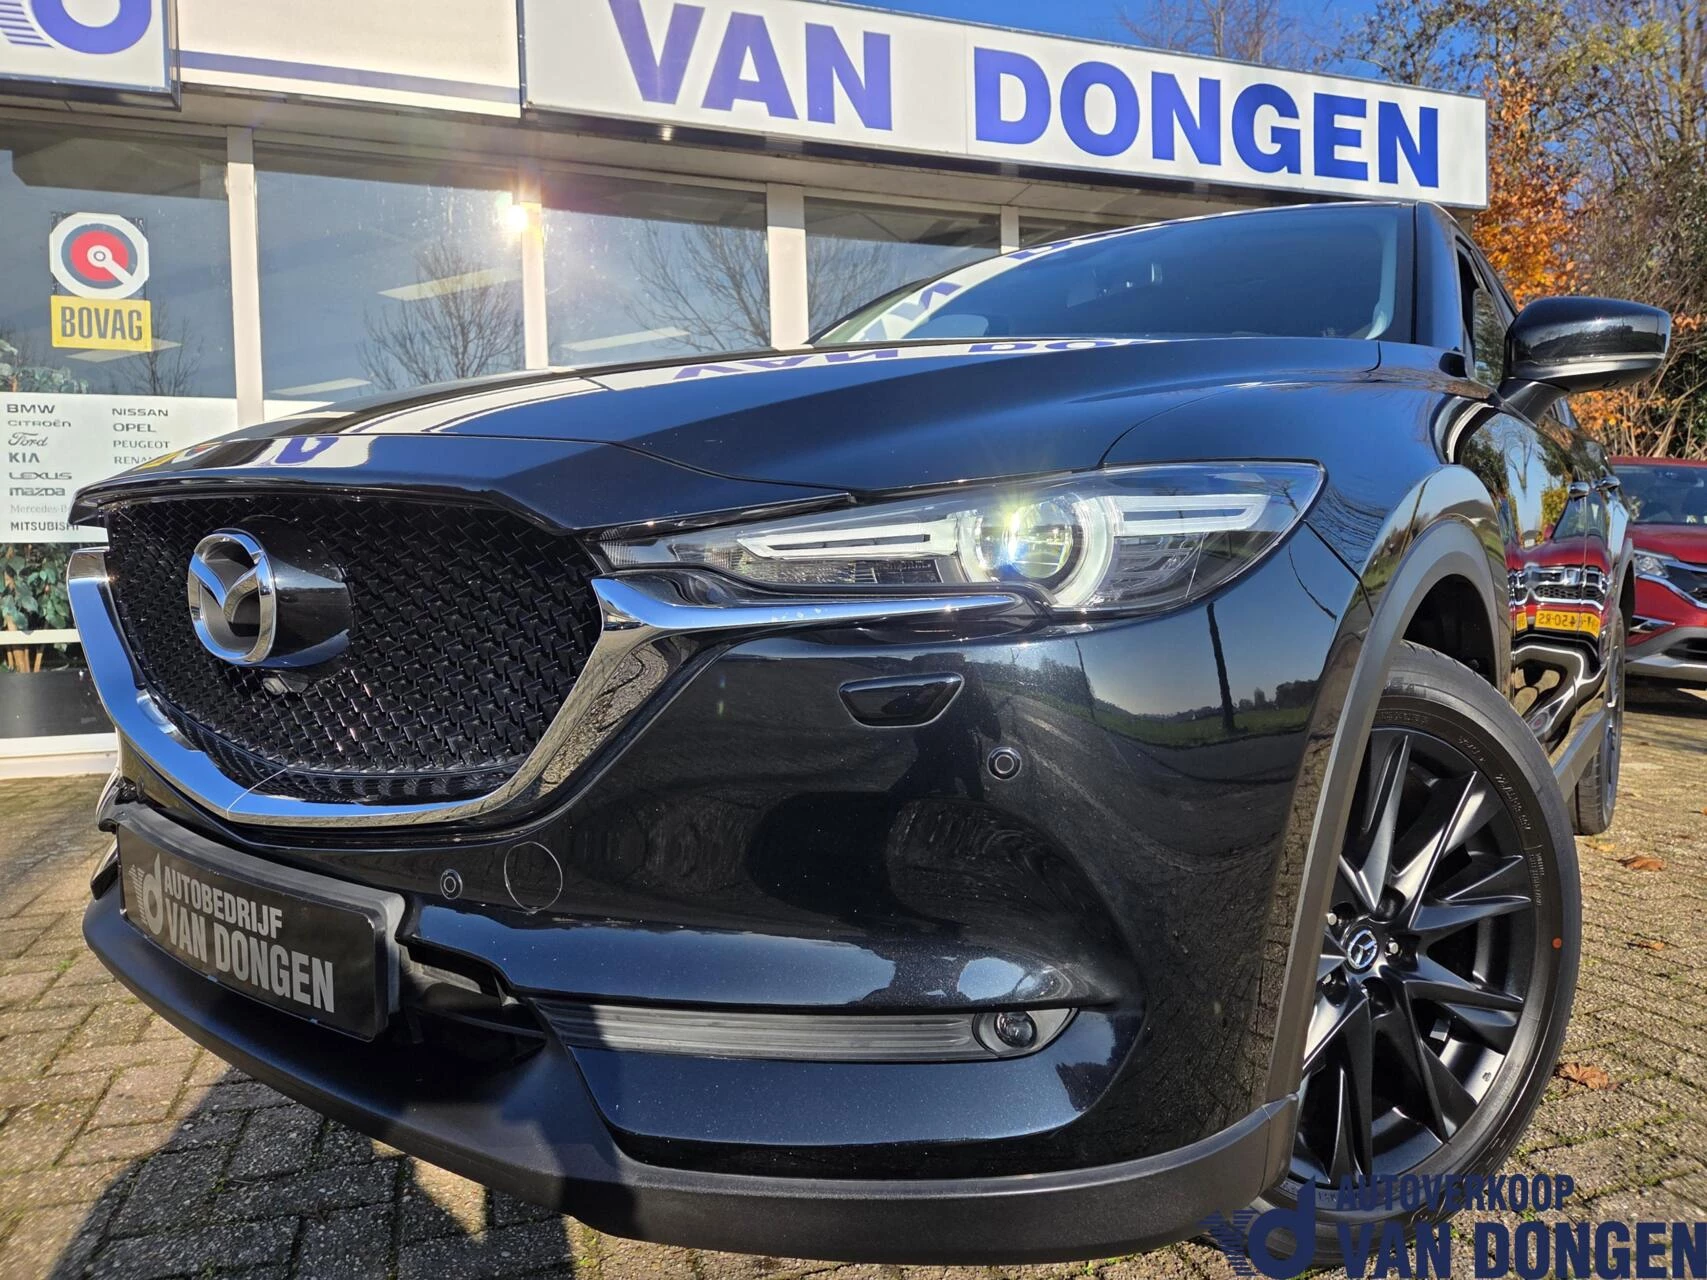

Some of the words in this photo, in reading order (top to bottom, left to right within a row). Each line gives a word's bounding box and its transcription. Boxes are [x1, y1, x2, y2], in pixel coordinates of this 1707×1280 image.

[609, 0, 893, 131] VAN
[974, 46, 1439, 188] DONGEN
[61, 306, 143, 341] BOVAG
[7, 403, 55, 414] BMW
[112, 408, 169, 417] NISSAN
[113, 422, 156, 433] OPEL
[8, 431, 48, 447] Ford
[113, 440, 170, 449] PEUGEOT
[8, 452, 40, 464] KIA
[9, 472, 73, 480] LEXUS
[164, 865, 283, 939] AUTOBEDRIJF
[165, 898, 207, 963] VAN
[213, 921, 335, 1013] DONGEN
